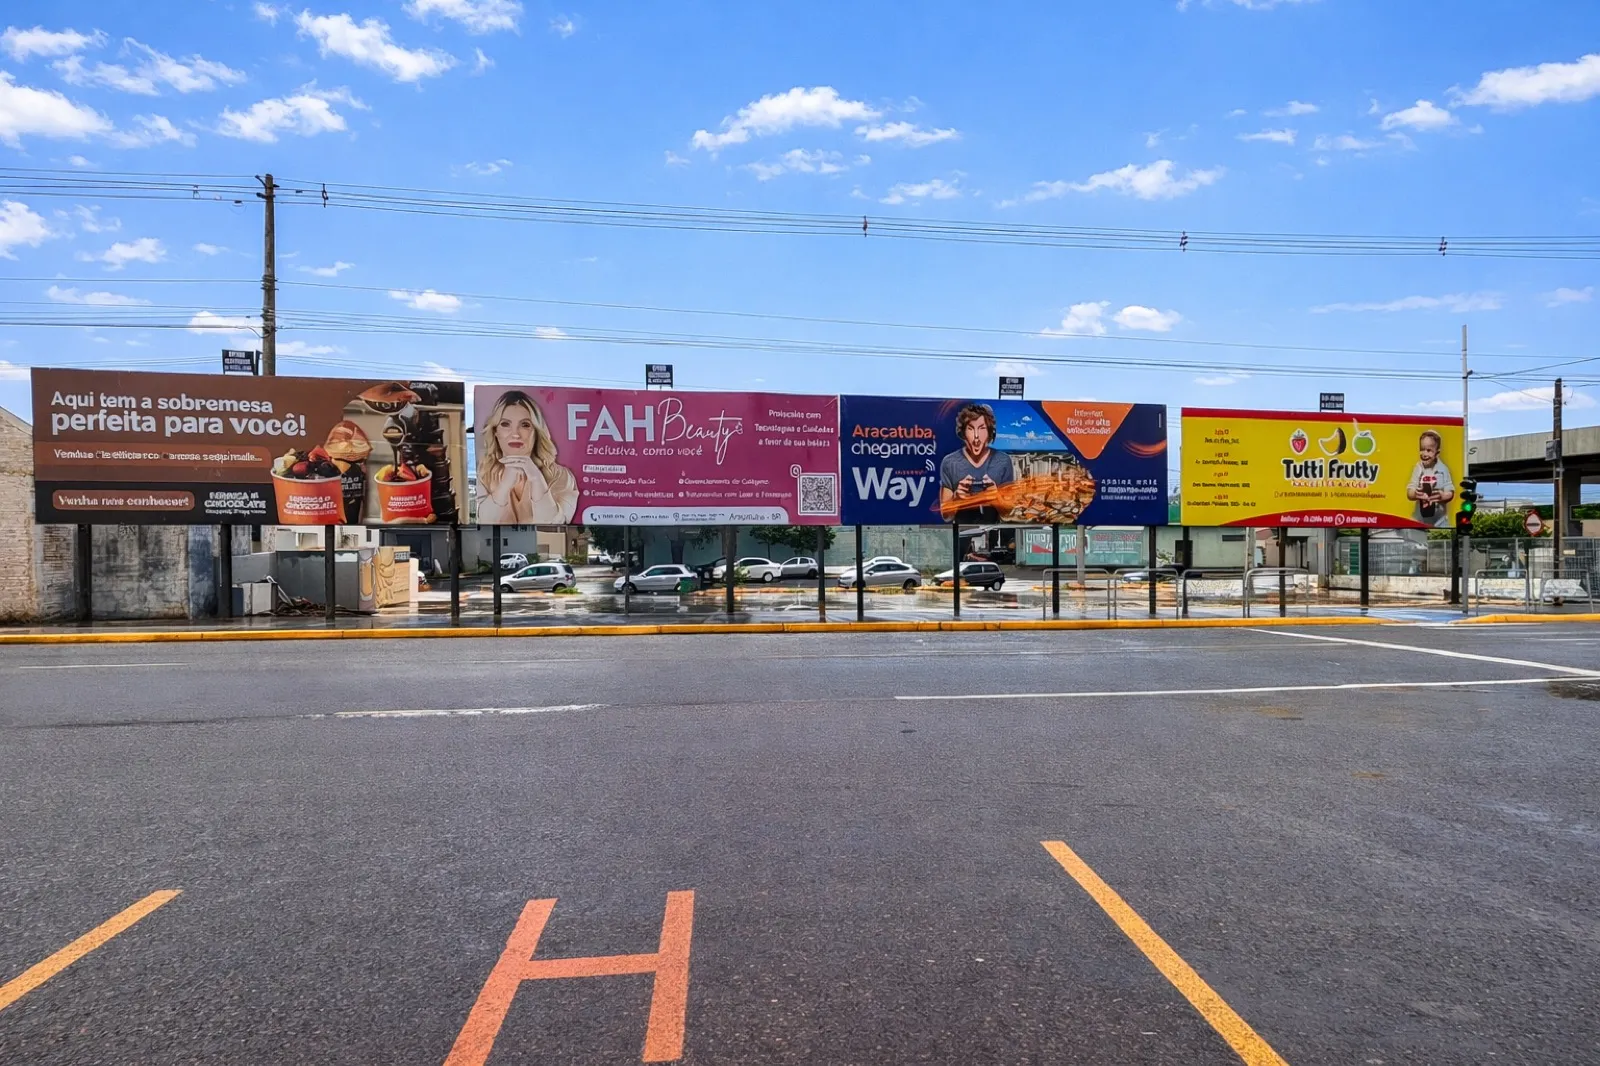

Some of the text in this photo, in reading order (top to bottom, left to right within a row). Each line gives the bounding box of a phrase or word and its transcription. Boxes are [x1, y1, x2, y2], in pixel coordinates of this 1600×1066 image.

[51, 391, 273, 413] Aqui tem a sobremesa
[52, 410, 307, 437] perfeita para você!
[567, 403, 655, 442] FAH
[657, 397, 743, 465] Beauty
[643, 447, 674, 456] como
[851, 439, 937, 459] chegamos!
[1282, 459, 1324, 479] Tutti
[852, 467, 927, 507] Way
